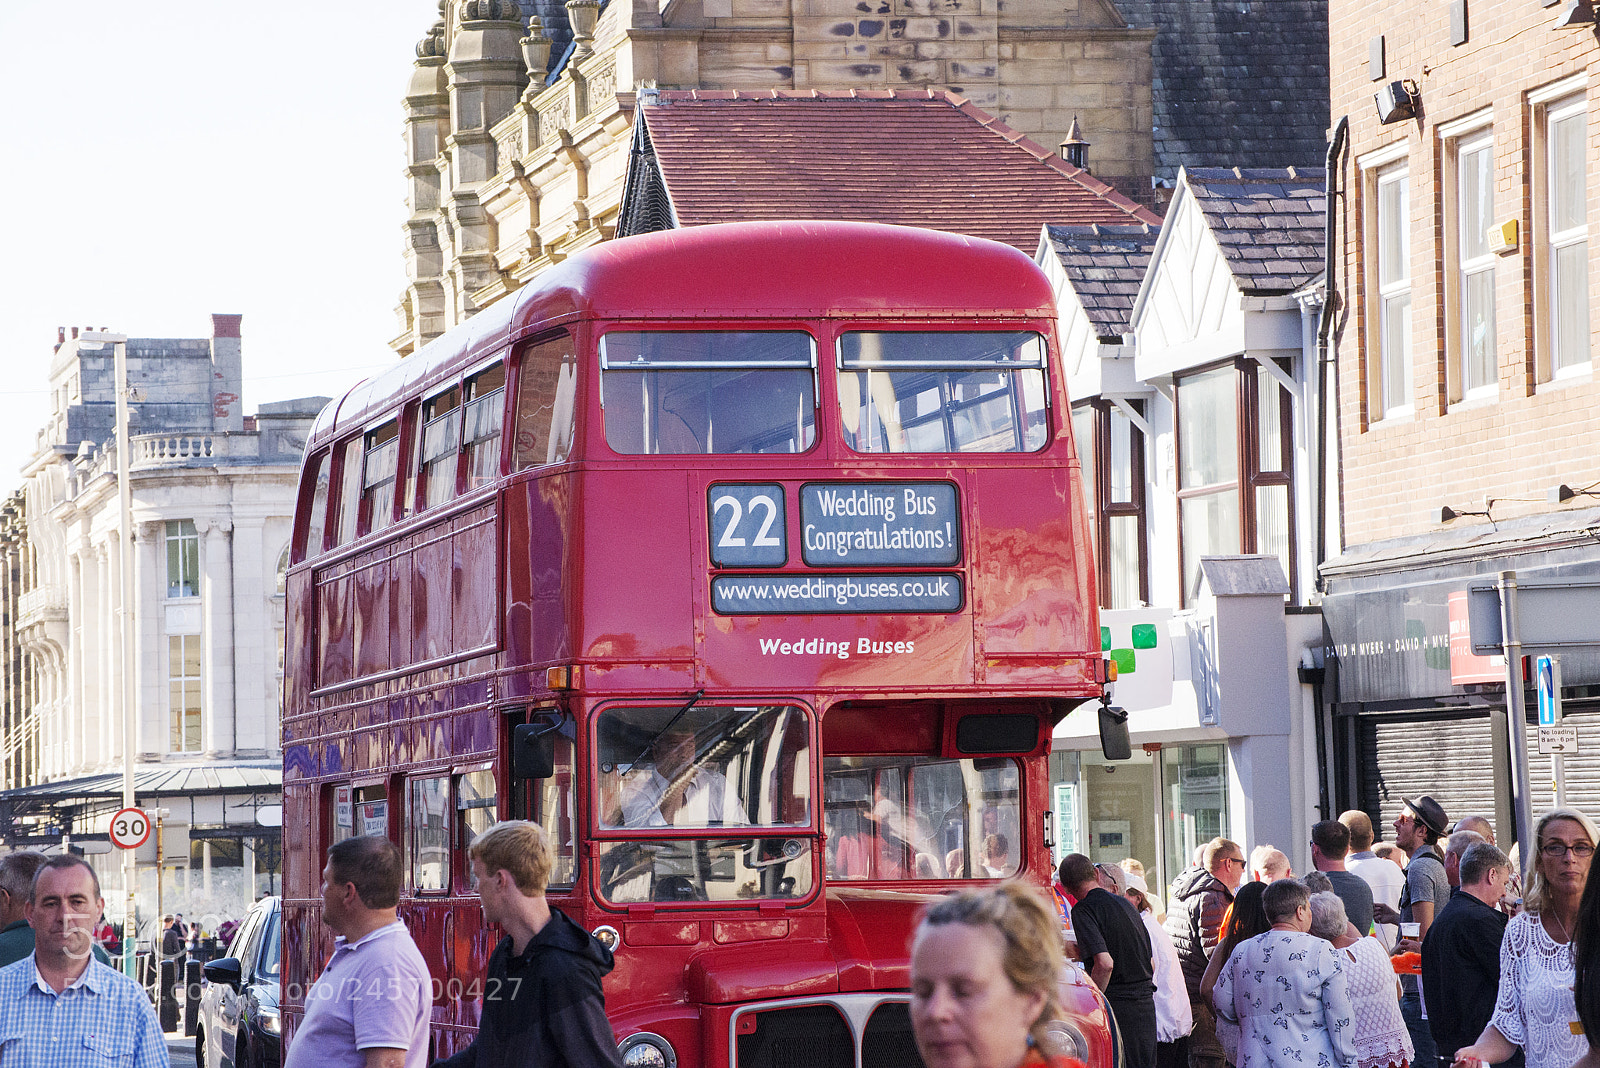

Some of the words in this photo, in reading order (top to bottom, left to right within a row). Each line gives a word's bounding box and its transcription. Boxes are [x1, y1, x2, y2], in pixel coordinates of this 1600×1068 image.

[817, 489, 896, 521] Wedding
[904, 489, 937, 516] Bus
[713, 495, 781, 548] 22
[805, 522, 953, 556] Congratulations!
[718, 577, 950, 604] www.weddingbuses.co.uk
[759, 638, 850, 659] Wedding
[857, 638, 915, 654] Buses
[1325, 643, 1348, 658] DAVID
[1351, 643, 1356, 656] H
[1360, 640, 1384, 656] MYERS
[1395, 637, 1419, 653] DAVID
[1424, 636, 1428, 649] H
[1432, 634, 1449, 648] MYE
[115, 819, 145, 836] 30
